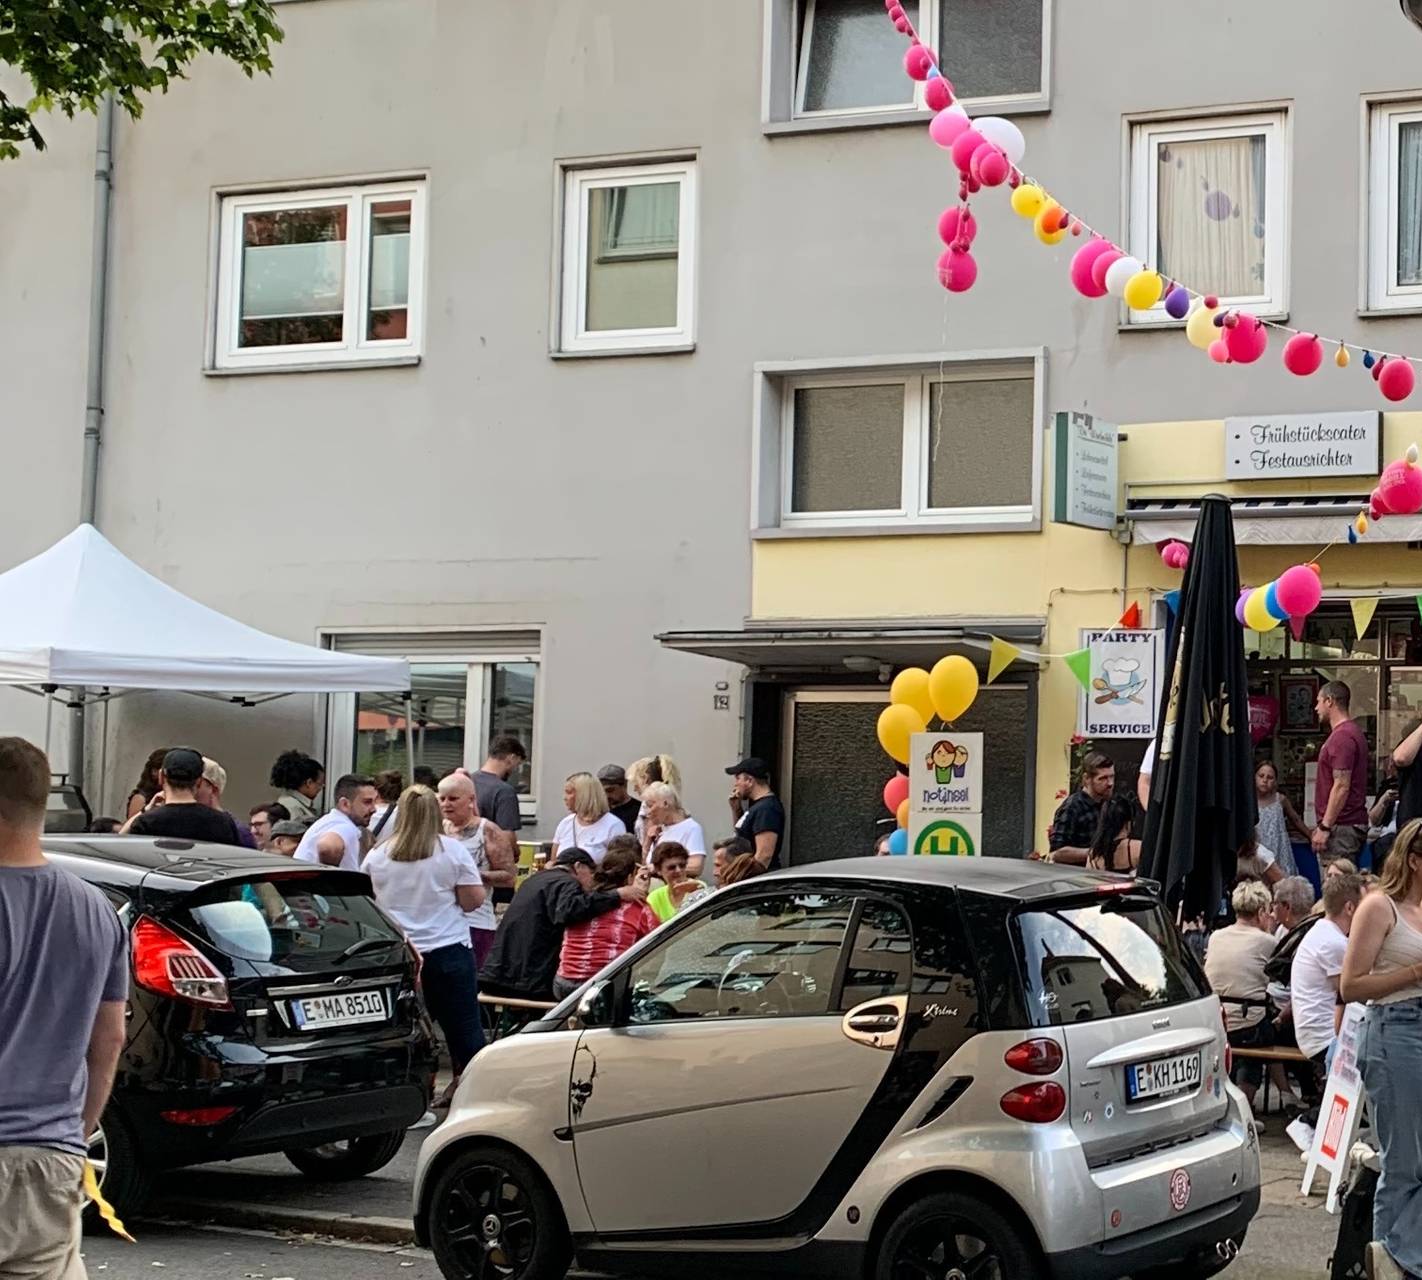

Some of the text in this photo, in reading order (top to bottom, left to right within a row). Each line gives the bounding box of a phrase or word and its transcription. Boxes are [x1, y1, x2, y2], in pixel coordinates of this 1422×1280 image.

[1250, 423, 1366, 445] Frühstückscater
[1250, 448, 1353, 470] Festausrichter
[1091, 633, 1152, 642] PARTY
[1089, 724, 1151, 734] SERVICE
[302, 994, 382, 1021] E MA 8510
[1137, 1057, 1199, 1092] E KH 1169
